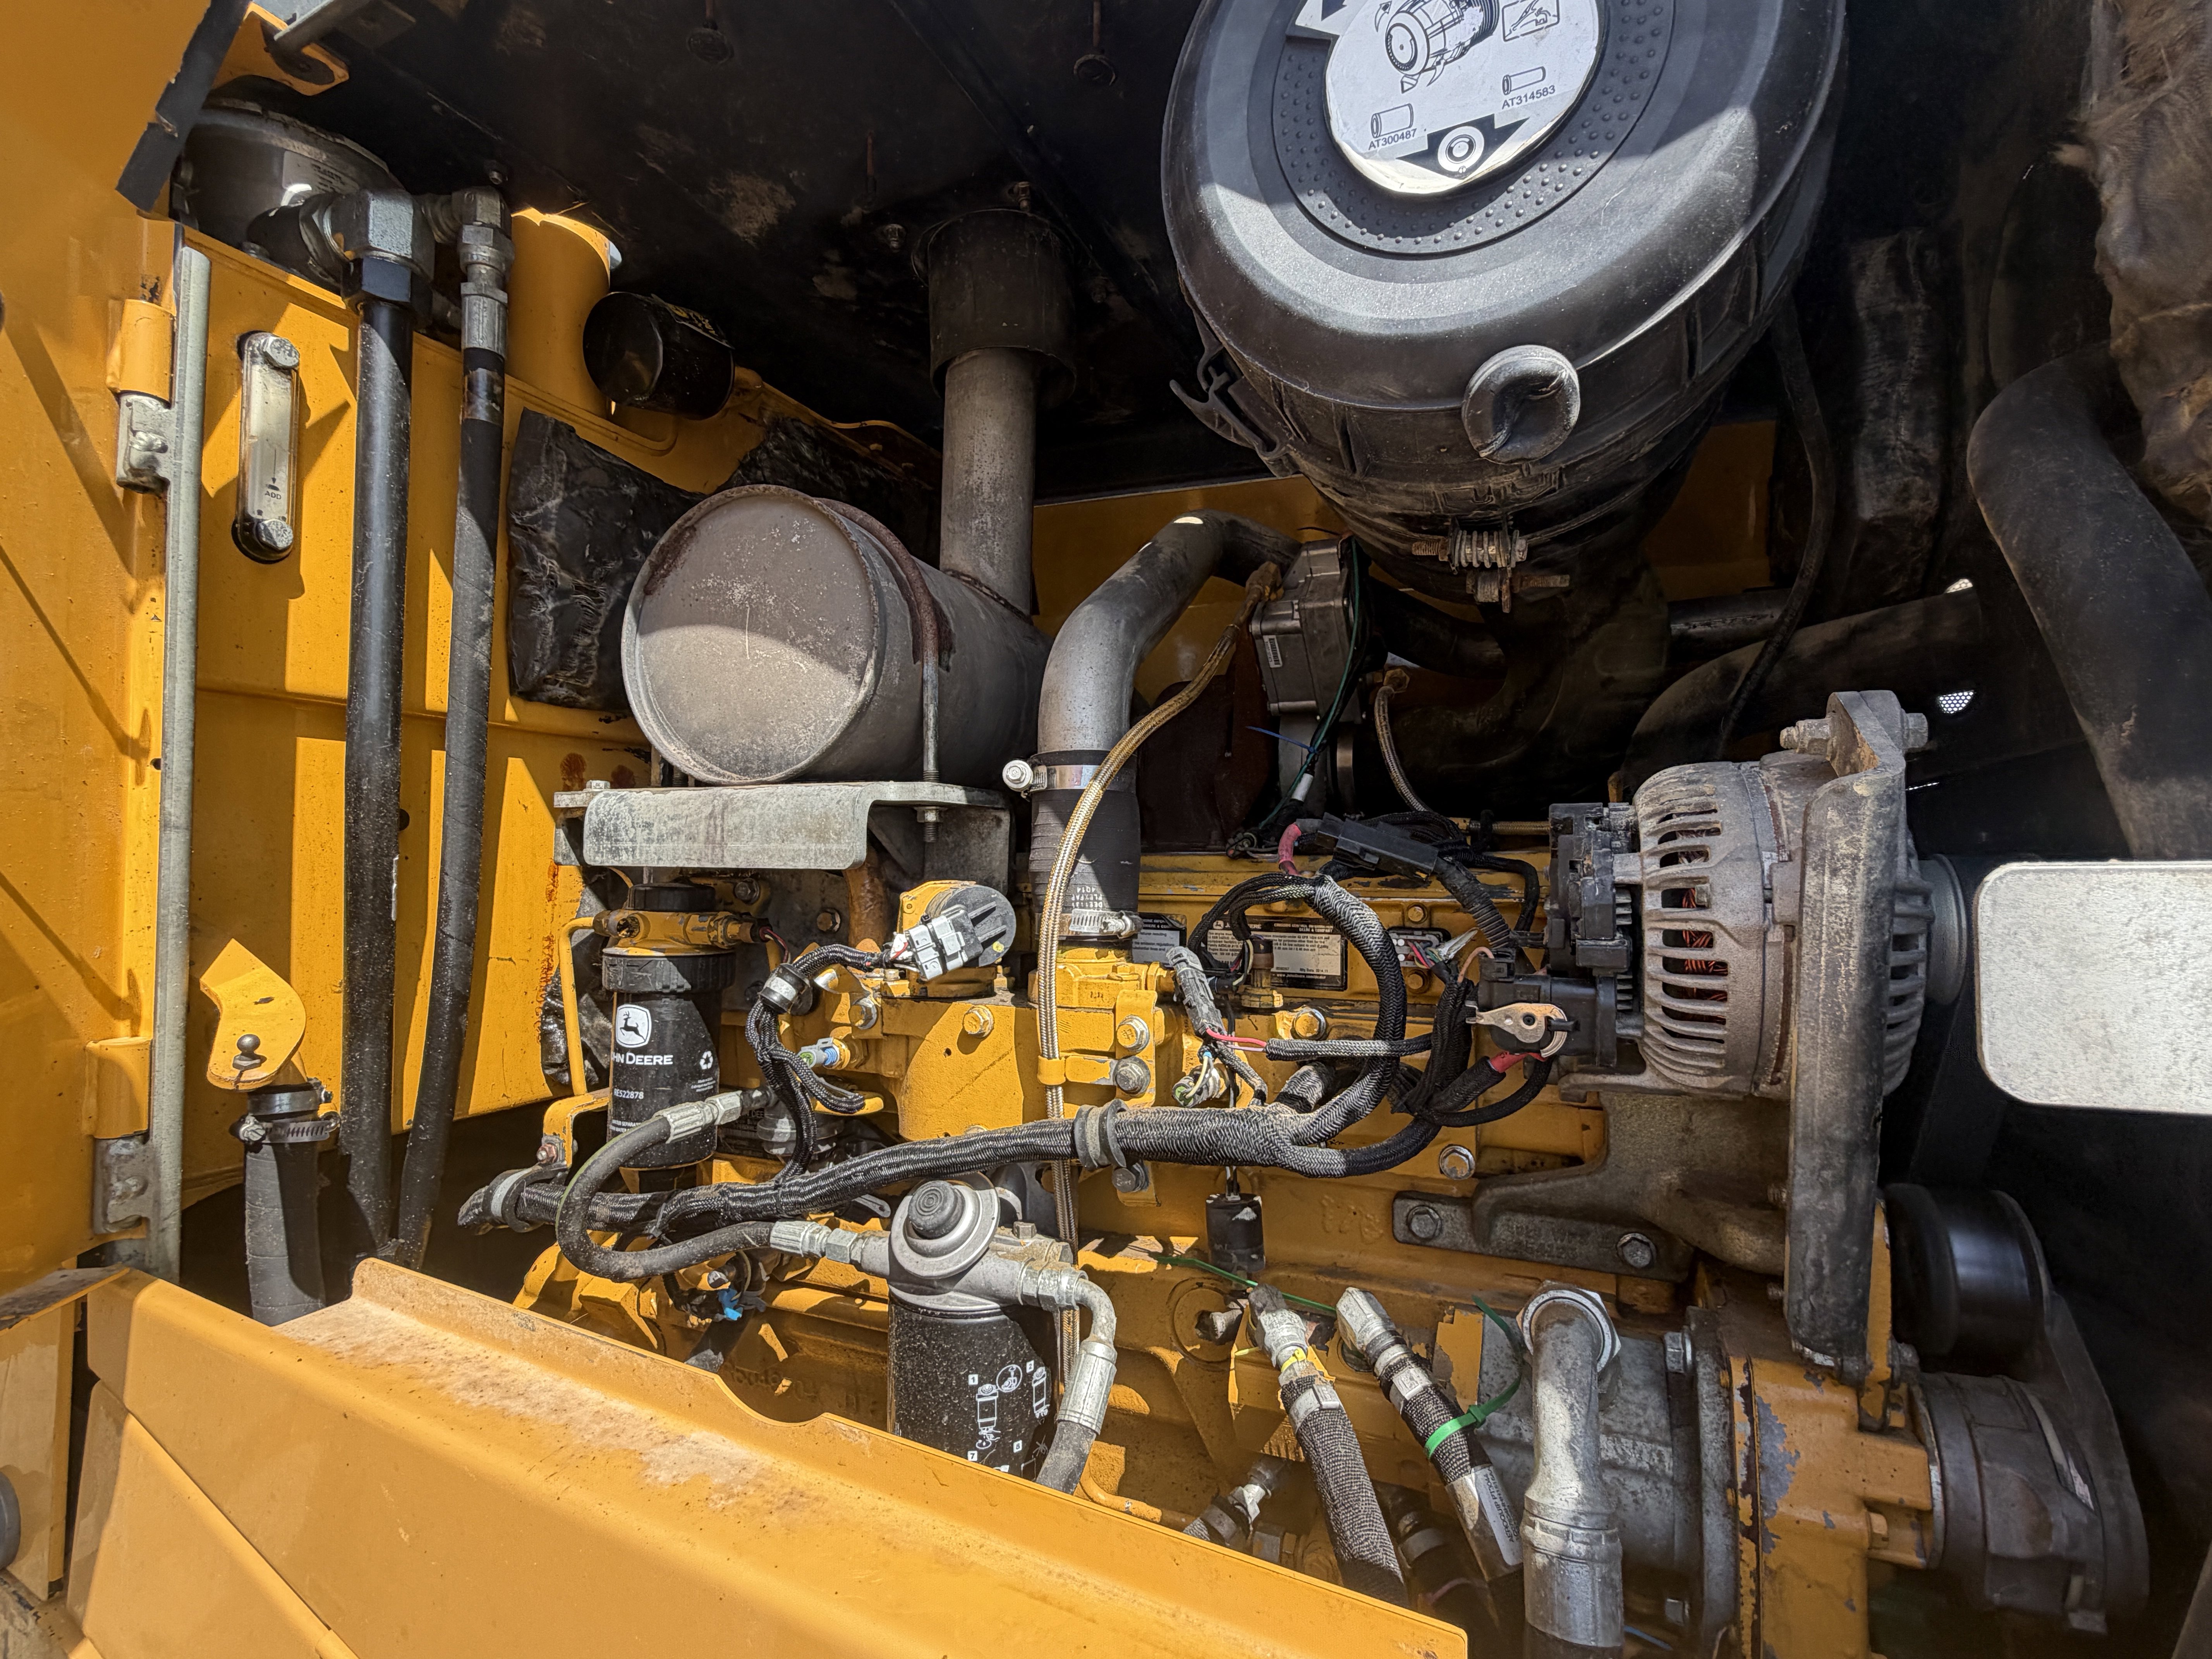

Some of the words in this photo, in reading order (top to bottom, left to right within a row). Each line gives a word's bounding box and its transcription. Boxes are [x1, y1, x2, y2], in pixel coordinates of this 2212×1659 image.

[1502, 84, 1555, 110] AT314583
[1369, 128, 1417, 150] AT300487
[264, 491, 282, 500] ADD
[611, 1052, 624, 1063] HN
[626, 1052, 673, 1065] DEERE
[1494, 1501, 1514, 1542] AEROQUIP
